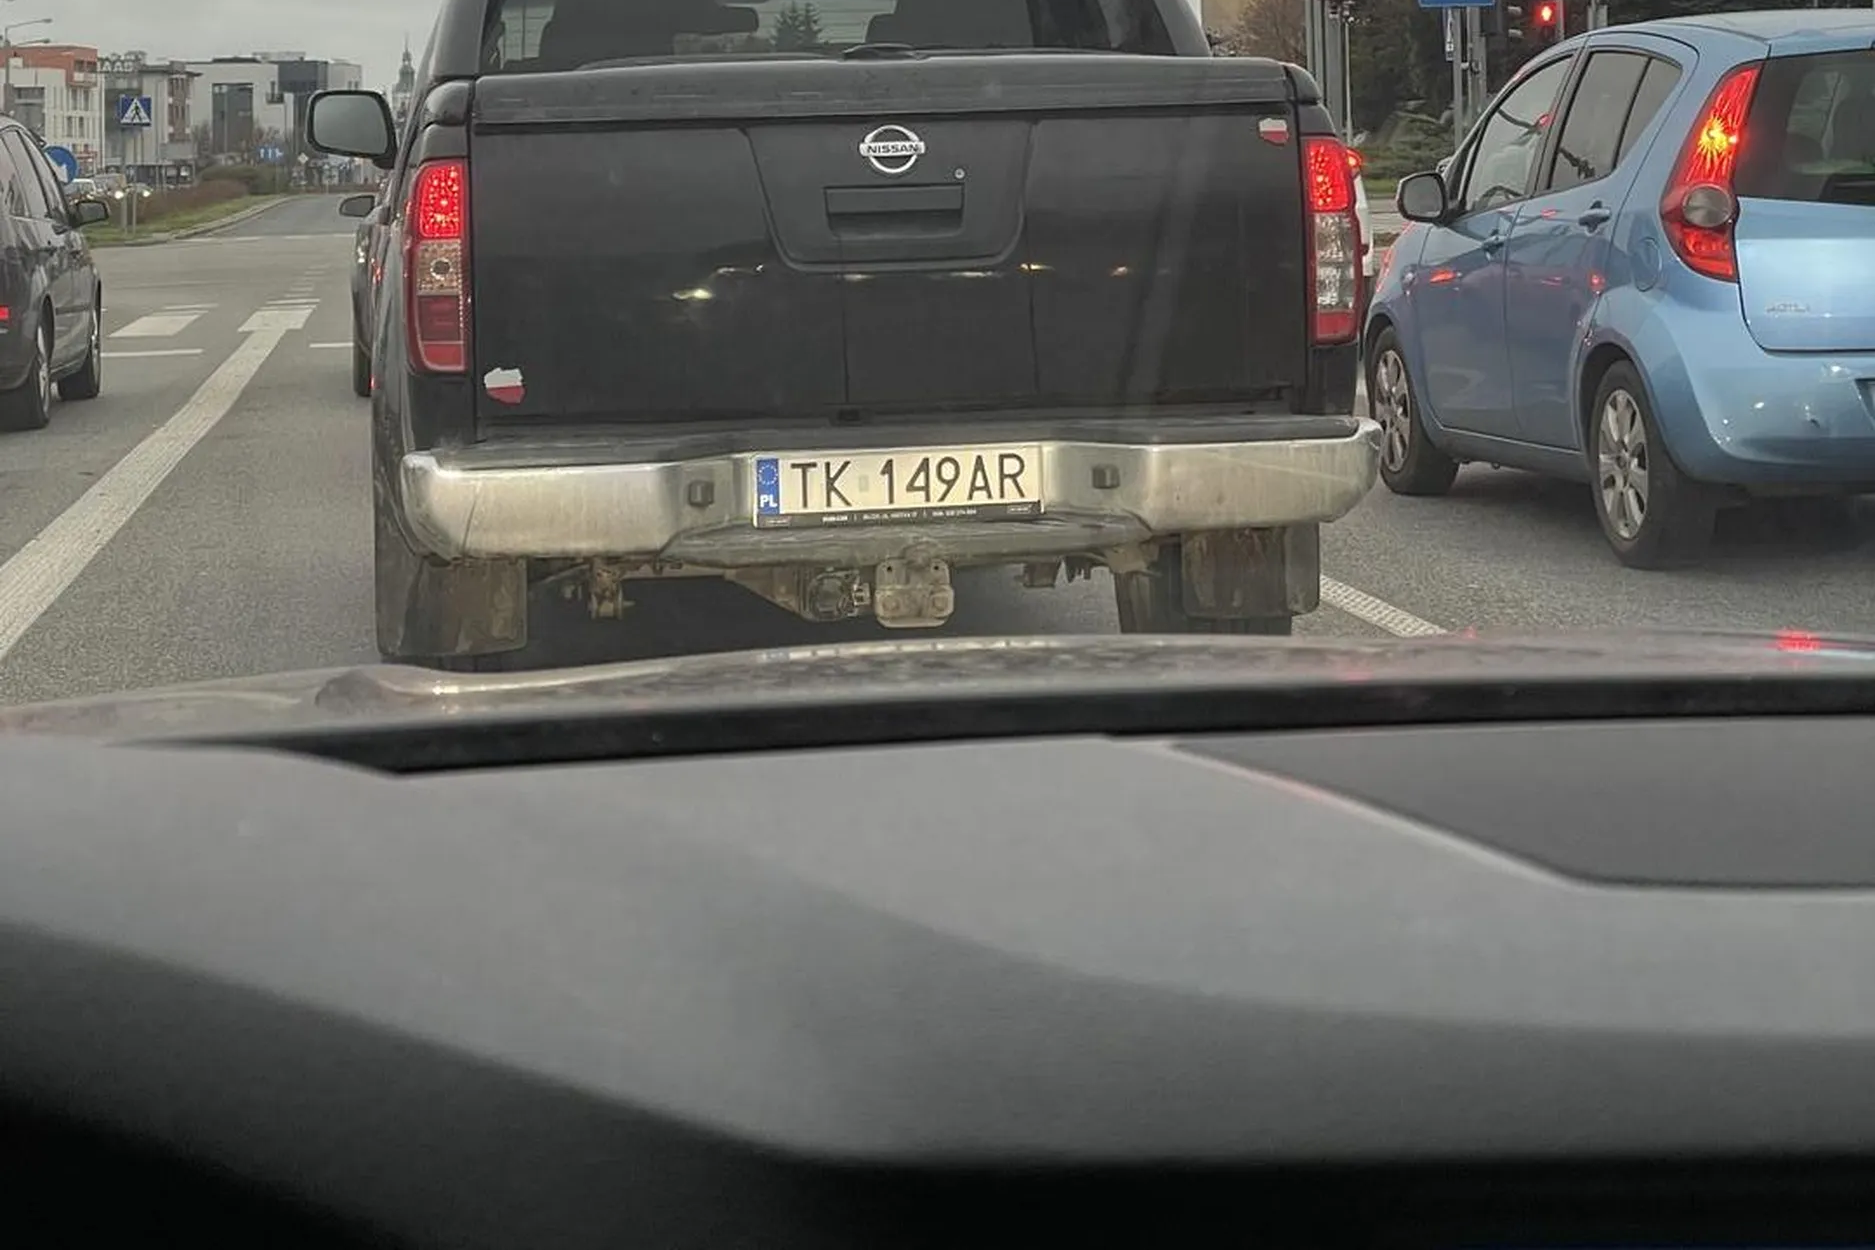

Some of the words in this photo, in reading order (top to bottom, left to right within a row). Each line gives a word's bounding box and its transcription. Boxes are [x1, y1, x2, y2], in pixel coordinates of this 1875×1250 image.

[867, 143, 918, 154] NISSAN
[790, 459, 852, 509] TK
[880, 452, 1026, 505] 149AR
[759, 494, 778, 508] PL
